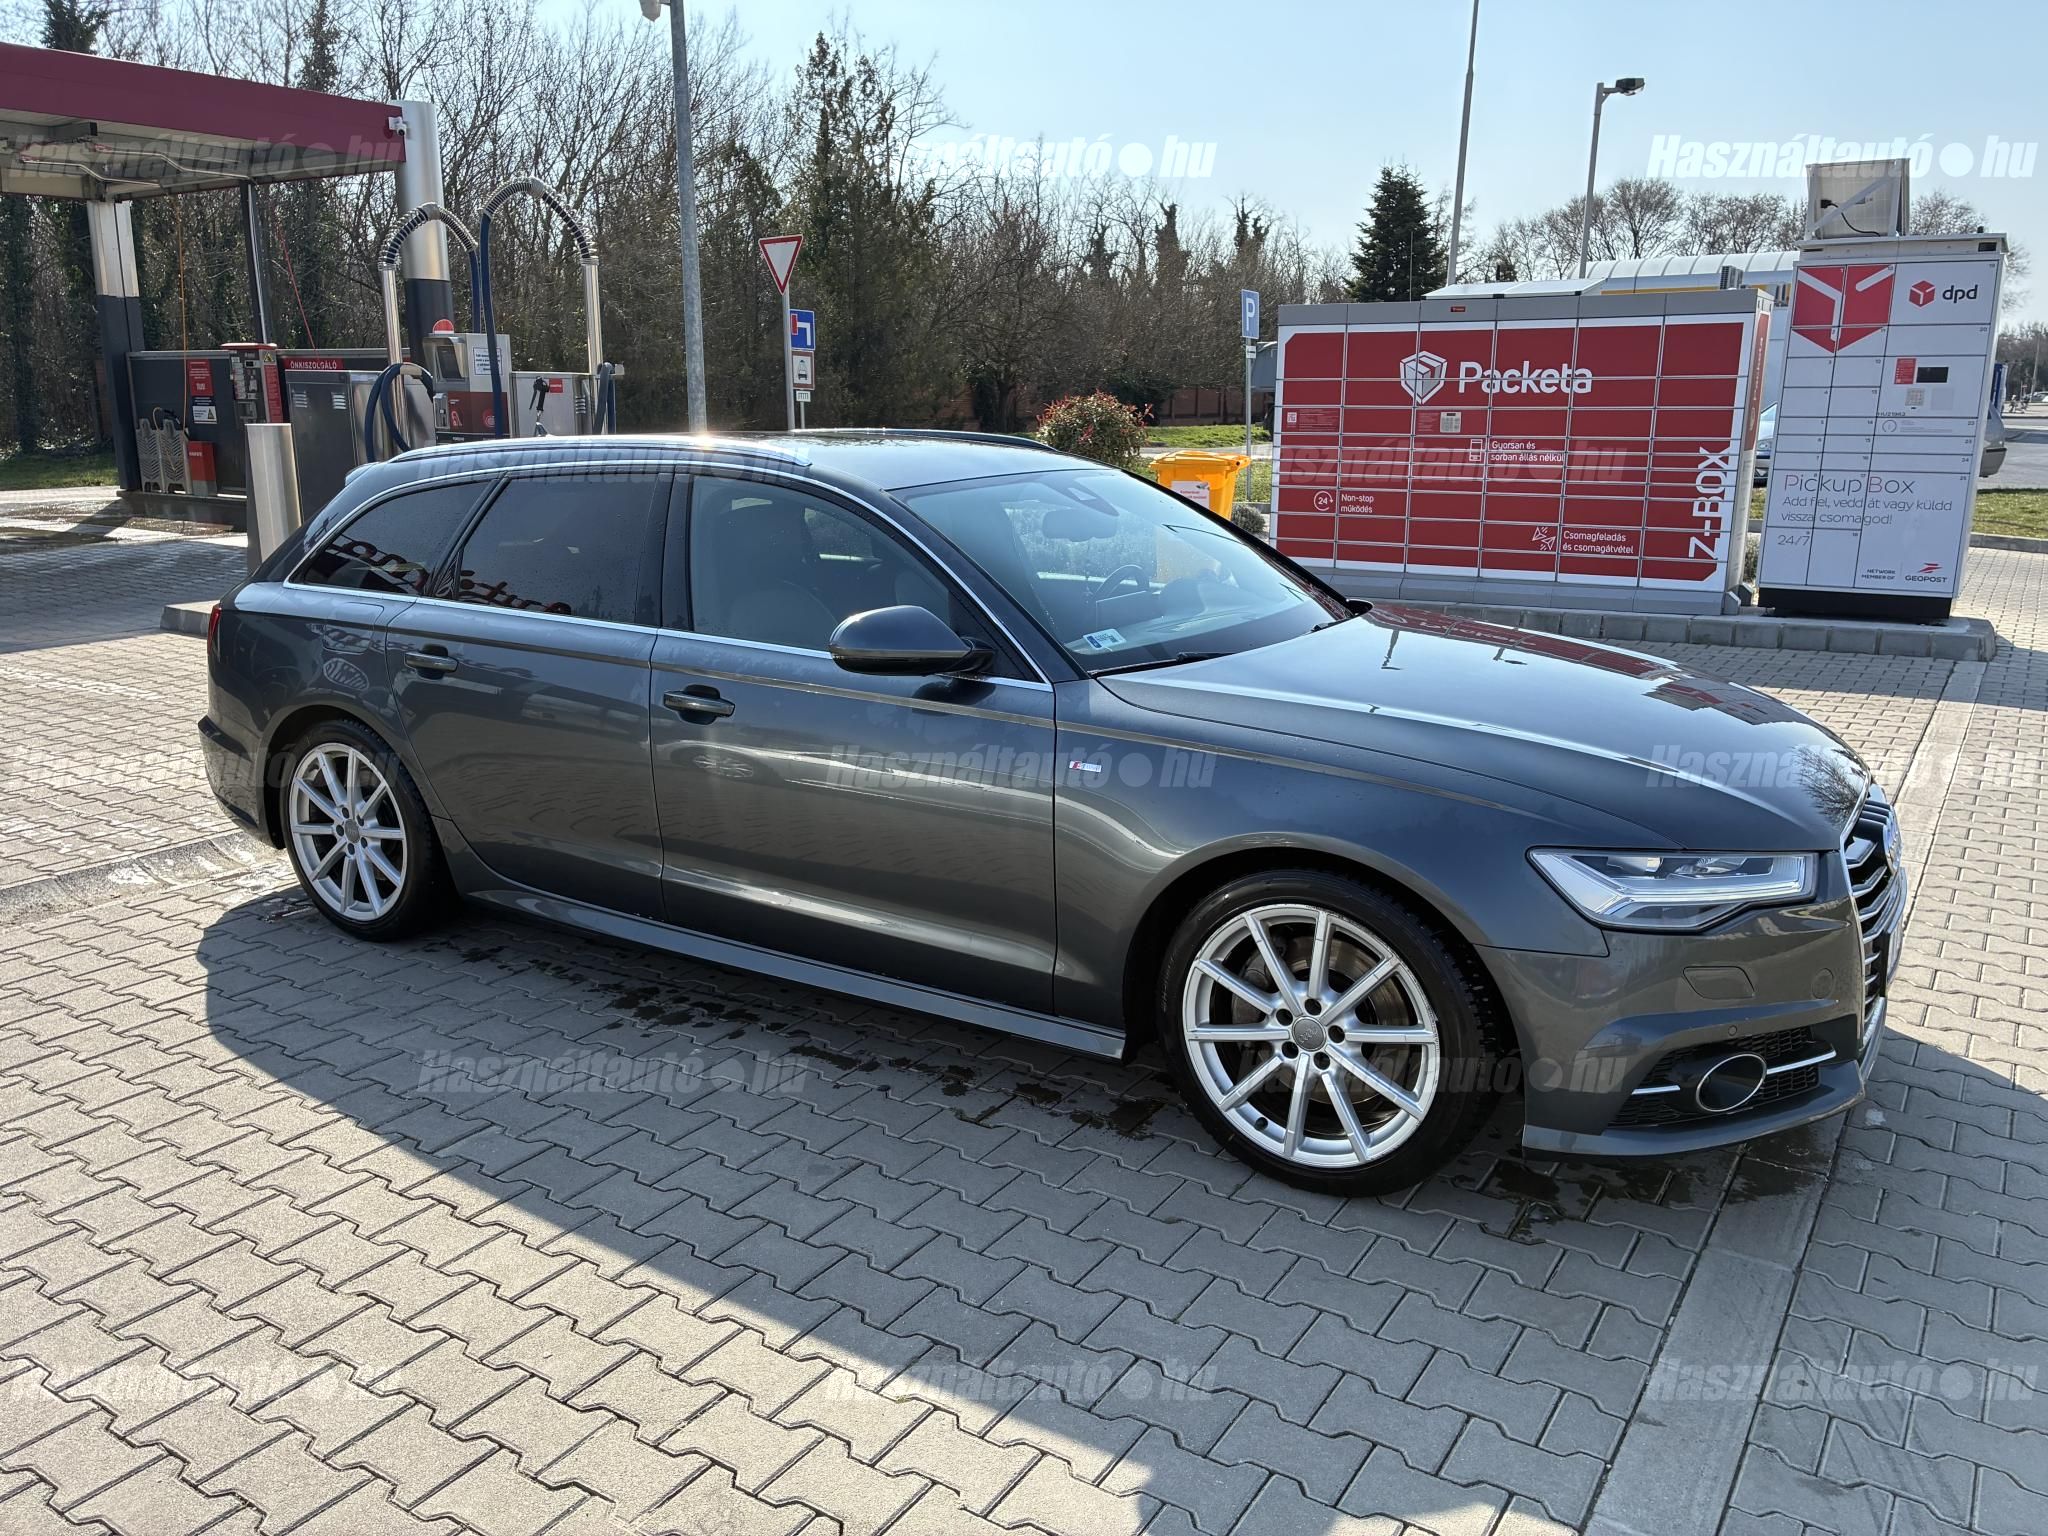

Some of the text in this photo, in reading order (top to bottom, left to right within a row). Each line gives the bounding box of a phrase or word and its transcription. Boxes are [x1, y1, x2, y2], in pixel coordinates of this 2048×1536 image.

[1942, 284, 1978, 303] dpd
[1245, 297, 1256, 331] P
[1458, 360, 1593, 394] Packeta
[1491, 440, 1536, 451] Gyorsan és
[1518, 452, 1538, 462] állás
[1539, 453, 1565, 462] nélkül
[1784, 474, 1916, 496] Pickup Box
[1318, 497, 1328, 505] 24
[1341, 494, 1374, 503] Non-stop
[1688, 446, 1730, 560] Z-BOX
[1782, 496, 1808, 506] Add
[1833, 498, 1864, 508] vedd
[1868, 498, 1880, 508] át
[1884, 502, 1914, 512] vagy
[1917, 500, 1952, 512] küldd
[1340, 504, 1373, 514] működés
[1781, 512, 1892, 526] vissza csomagod!
[1563, 530, 1627, 542] Csomagfeladás
[1778, 534, 1811, 546] 24/7
[1562, 542, 1634, 554] és csomagátvétel
[1905, 575, 1948, 584] GEOPOST
